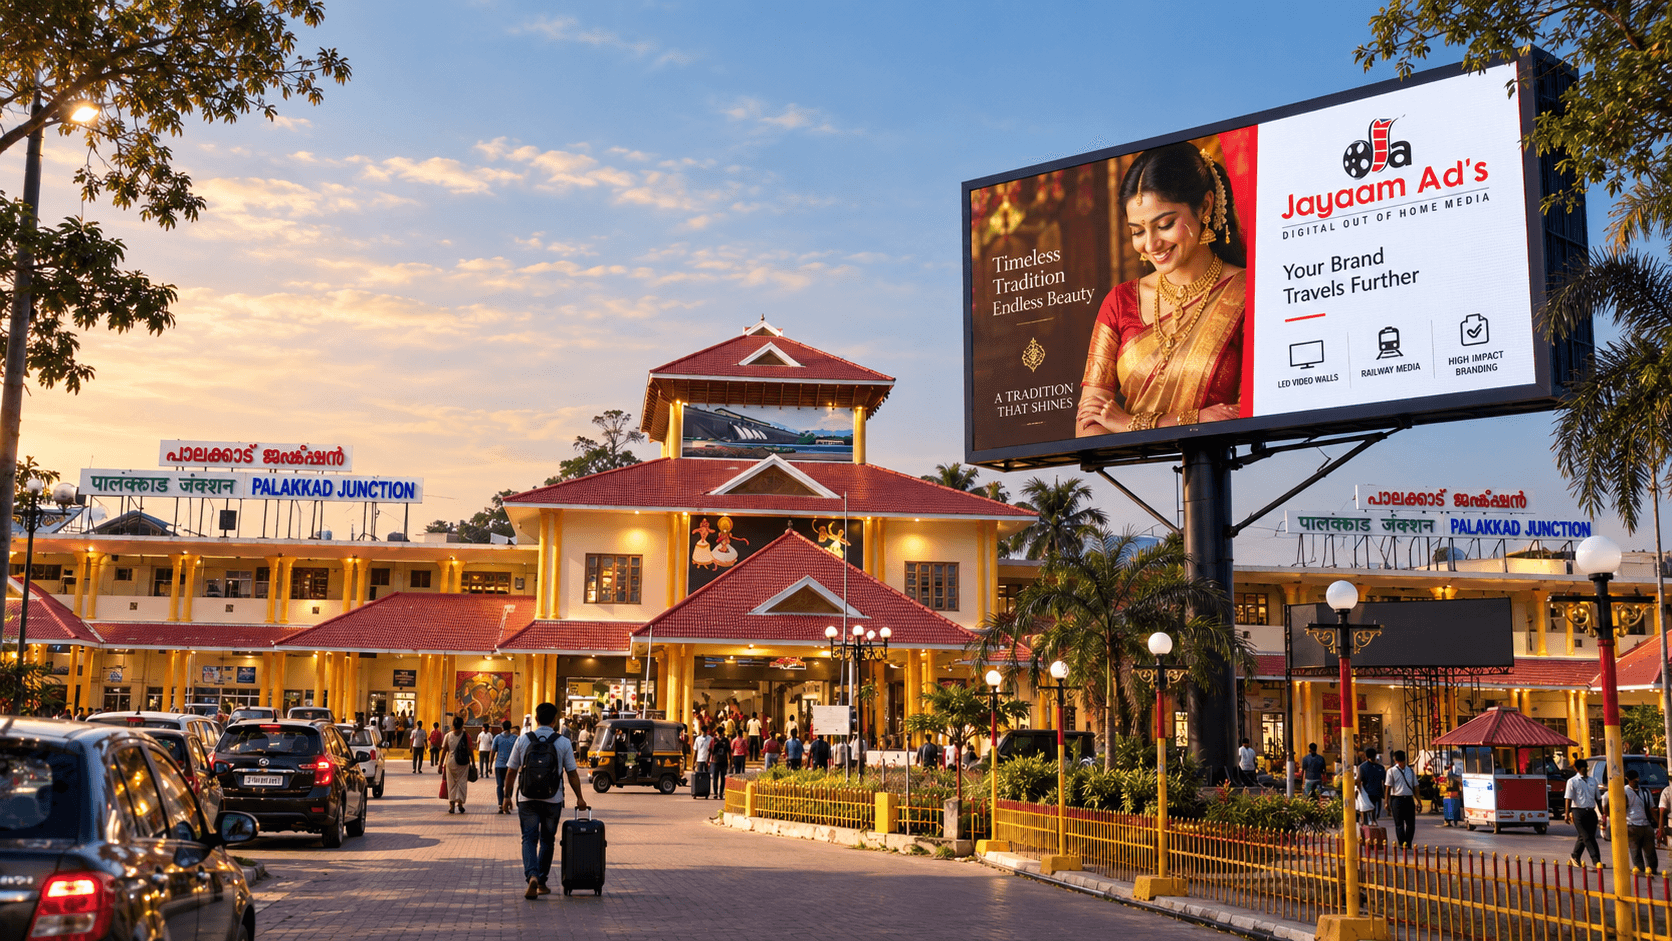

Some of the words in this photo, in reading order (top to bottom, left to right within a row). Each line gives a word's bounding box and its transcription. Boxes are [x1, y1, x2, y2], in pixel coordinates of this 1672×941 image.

[1281, 177, 1406, 219] Jayaam
[1417, 158, 1489, 193] Ad's
[1282, 223, 1335, 240] DIGITAL
[1343, 215, 1368, 228] OUT
[1376, 211, 1393, 222] OF
[1400, 202, 1437, 218] HOME
[1445, 192, 1490, 209] MEDIA
[992, 248, 1061, 273] Timeless
[1283, 262, 1325, 281] Your
[1331, 246, 1384, 273] Brand
[992, 270, 1065, 295] Tradition
[1283, 280, 1345, 304] Travels
[1351, 269, 1420, 294] Further
[993, 295, 1043, 316] Endless
[1047, 287, 1095, 307] Beauty
[1448, 354, 1469, 366] HIGH
[1471, 350, 1504, 363] IMPACT
[1277, 379, 1291, 388] LED
[1292, 376, 1314, 387] VIDEO
[1314, 373, 1339, 384] WALLS
[1361, 366, 1394, 378] RAILWAY
[1396, 362, 1421, 374] MEDIA
[1455, 363, 1498, 377] BRANDING
[994, 392, 1003, 405] A
[1005, 383, 1074, 403] TRADITION
[997, 403, 1028, 418] THAT
[1031, 397, 1073, 414] SHINES
[252, 477, 333, 497] PALAKKAD
[337, 479, 415, 499] JUNCTION
[1450, 518, 1520, 536] PALAKKAD
[1525, 520, 1591, 538] JUNCTION
